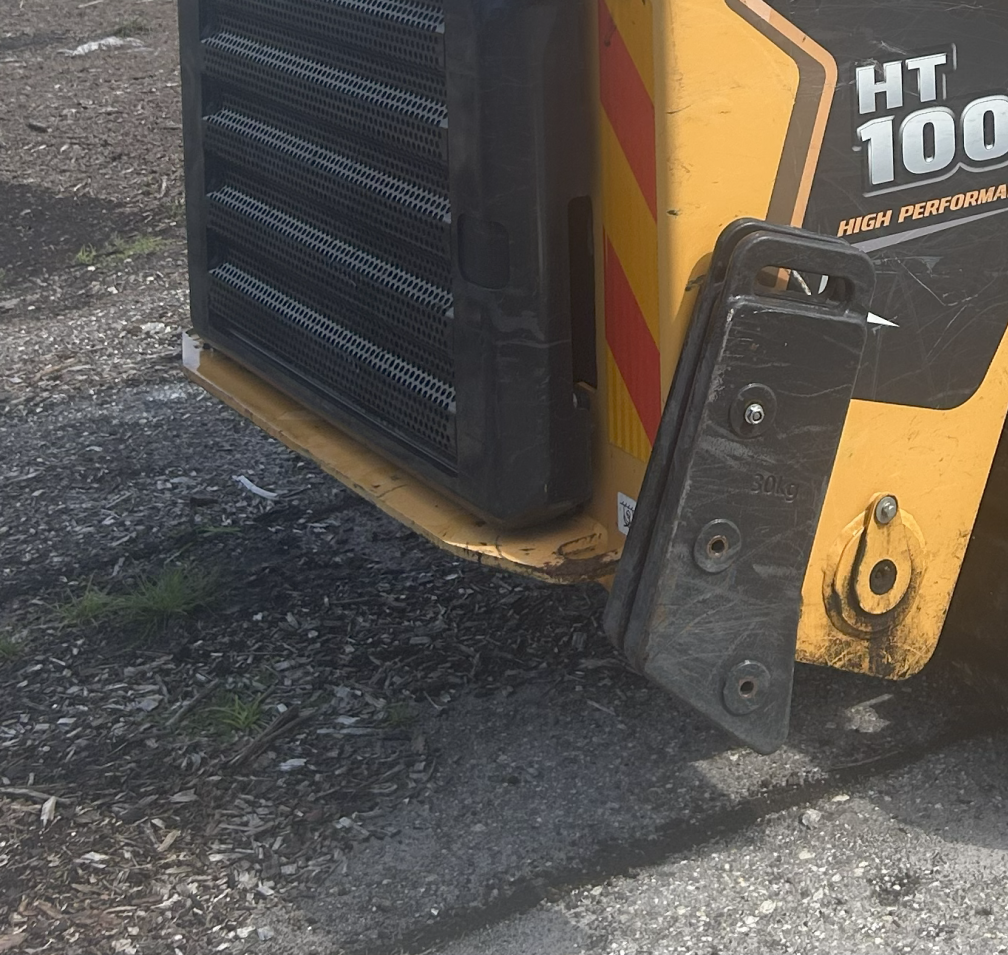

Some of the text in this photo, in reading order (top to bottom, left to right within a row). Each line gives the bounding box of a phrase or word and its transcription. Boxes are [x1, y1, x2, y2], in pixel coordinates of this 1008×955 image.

[855, 52, 947, 114] HT
[837, 210, 892, 237] HIGH
[751, 474, 800, 503] 30kg
